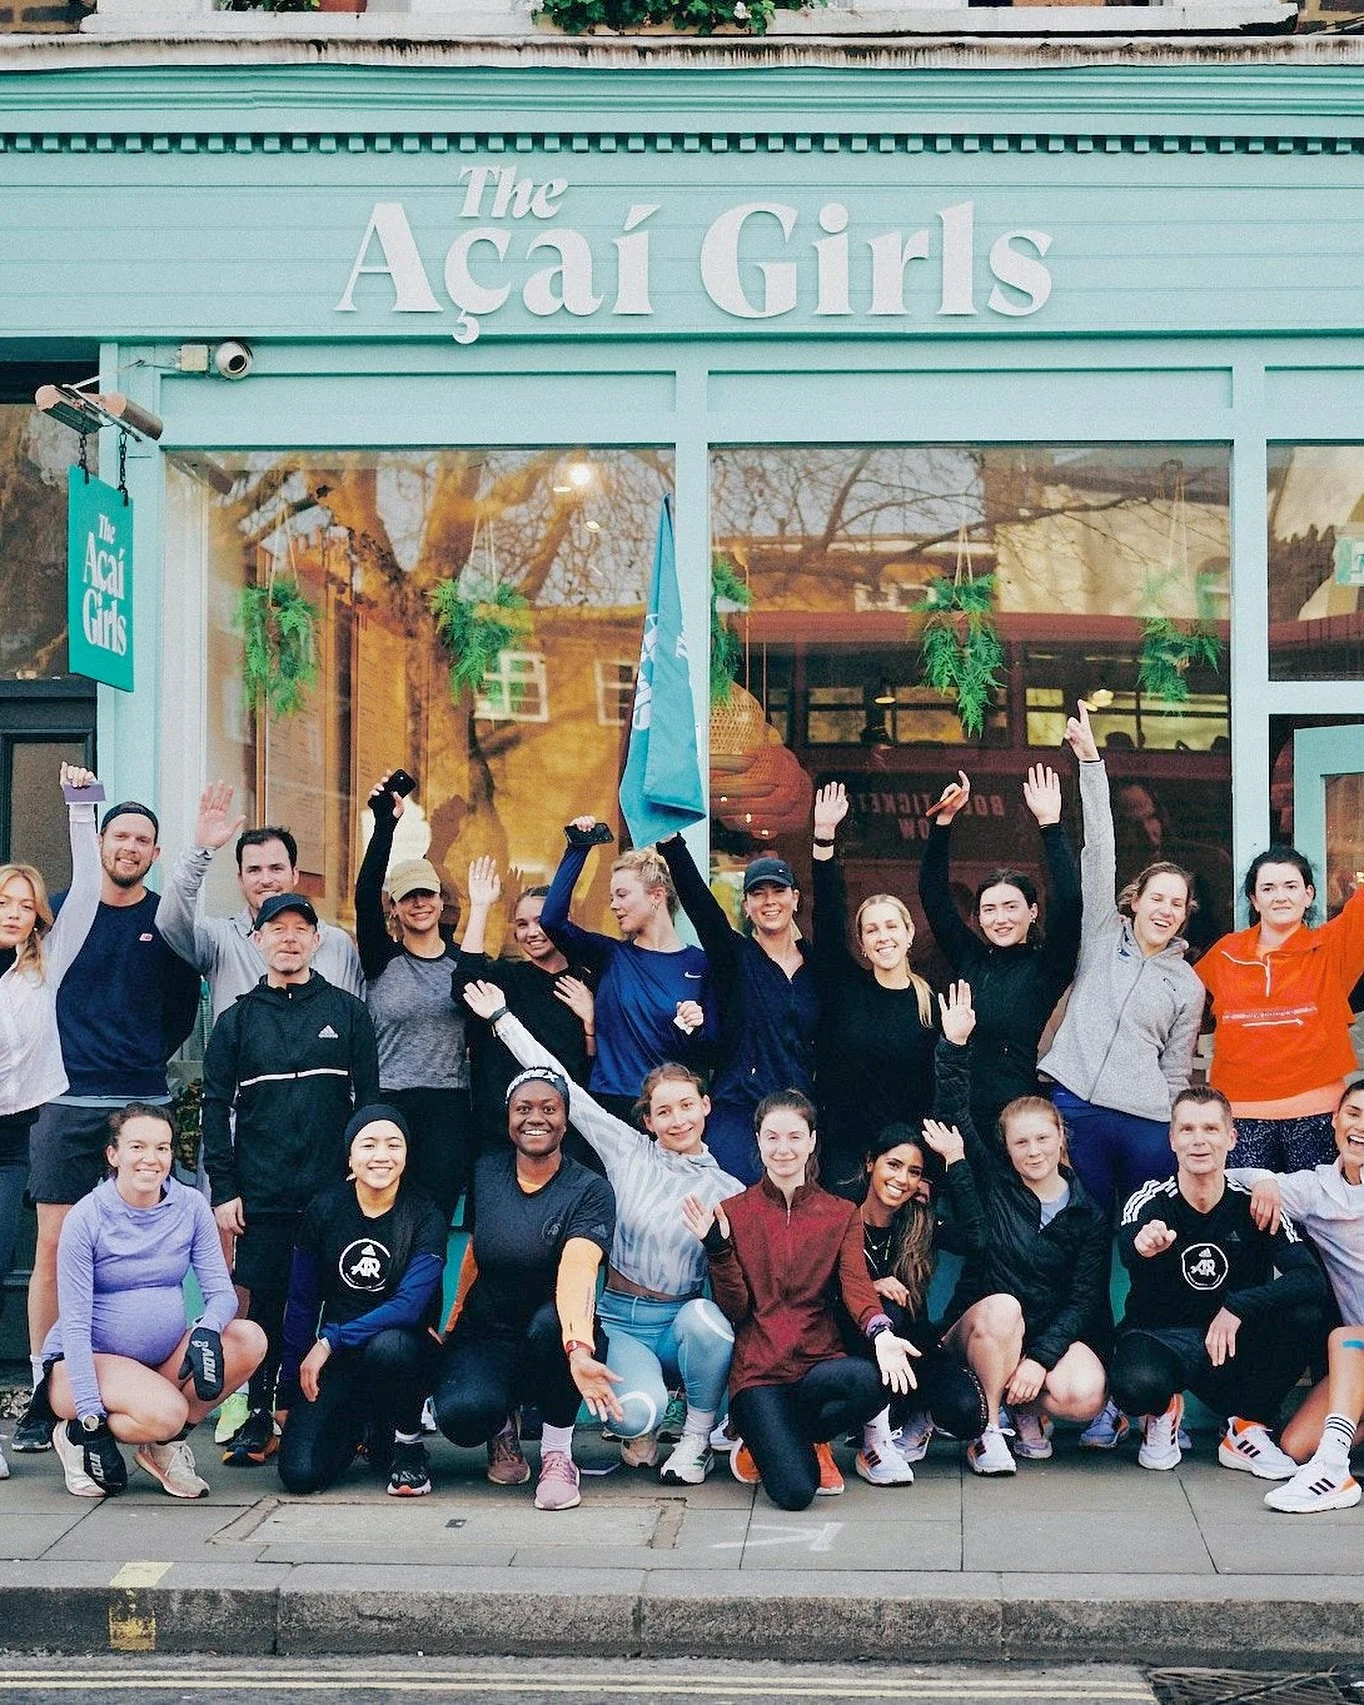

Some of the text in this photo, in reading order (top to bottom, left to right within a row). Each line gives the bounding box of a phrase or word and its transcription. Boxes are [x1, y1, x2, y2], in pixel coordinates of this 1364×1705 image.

[457, 164, 568, 219] The
[334, 200, 1053, 345] Açaí Girls
[98, 513, 116, 545] The
[82, 587, 127, 657] Girls
